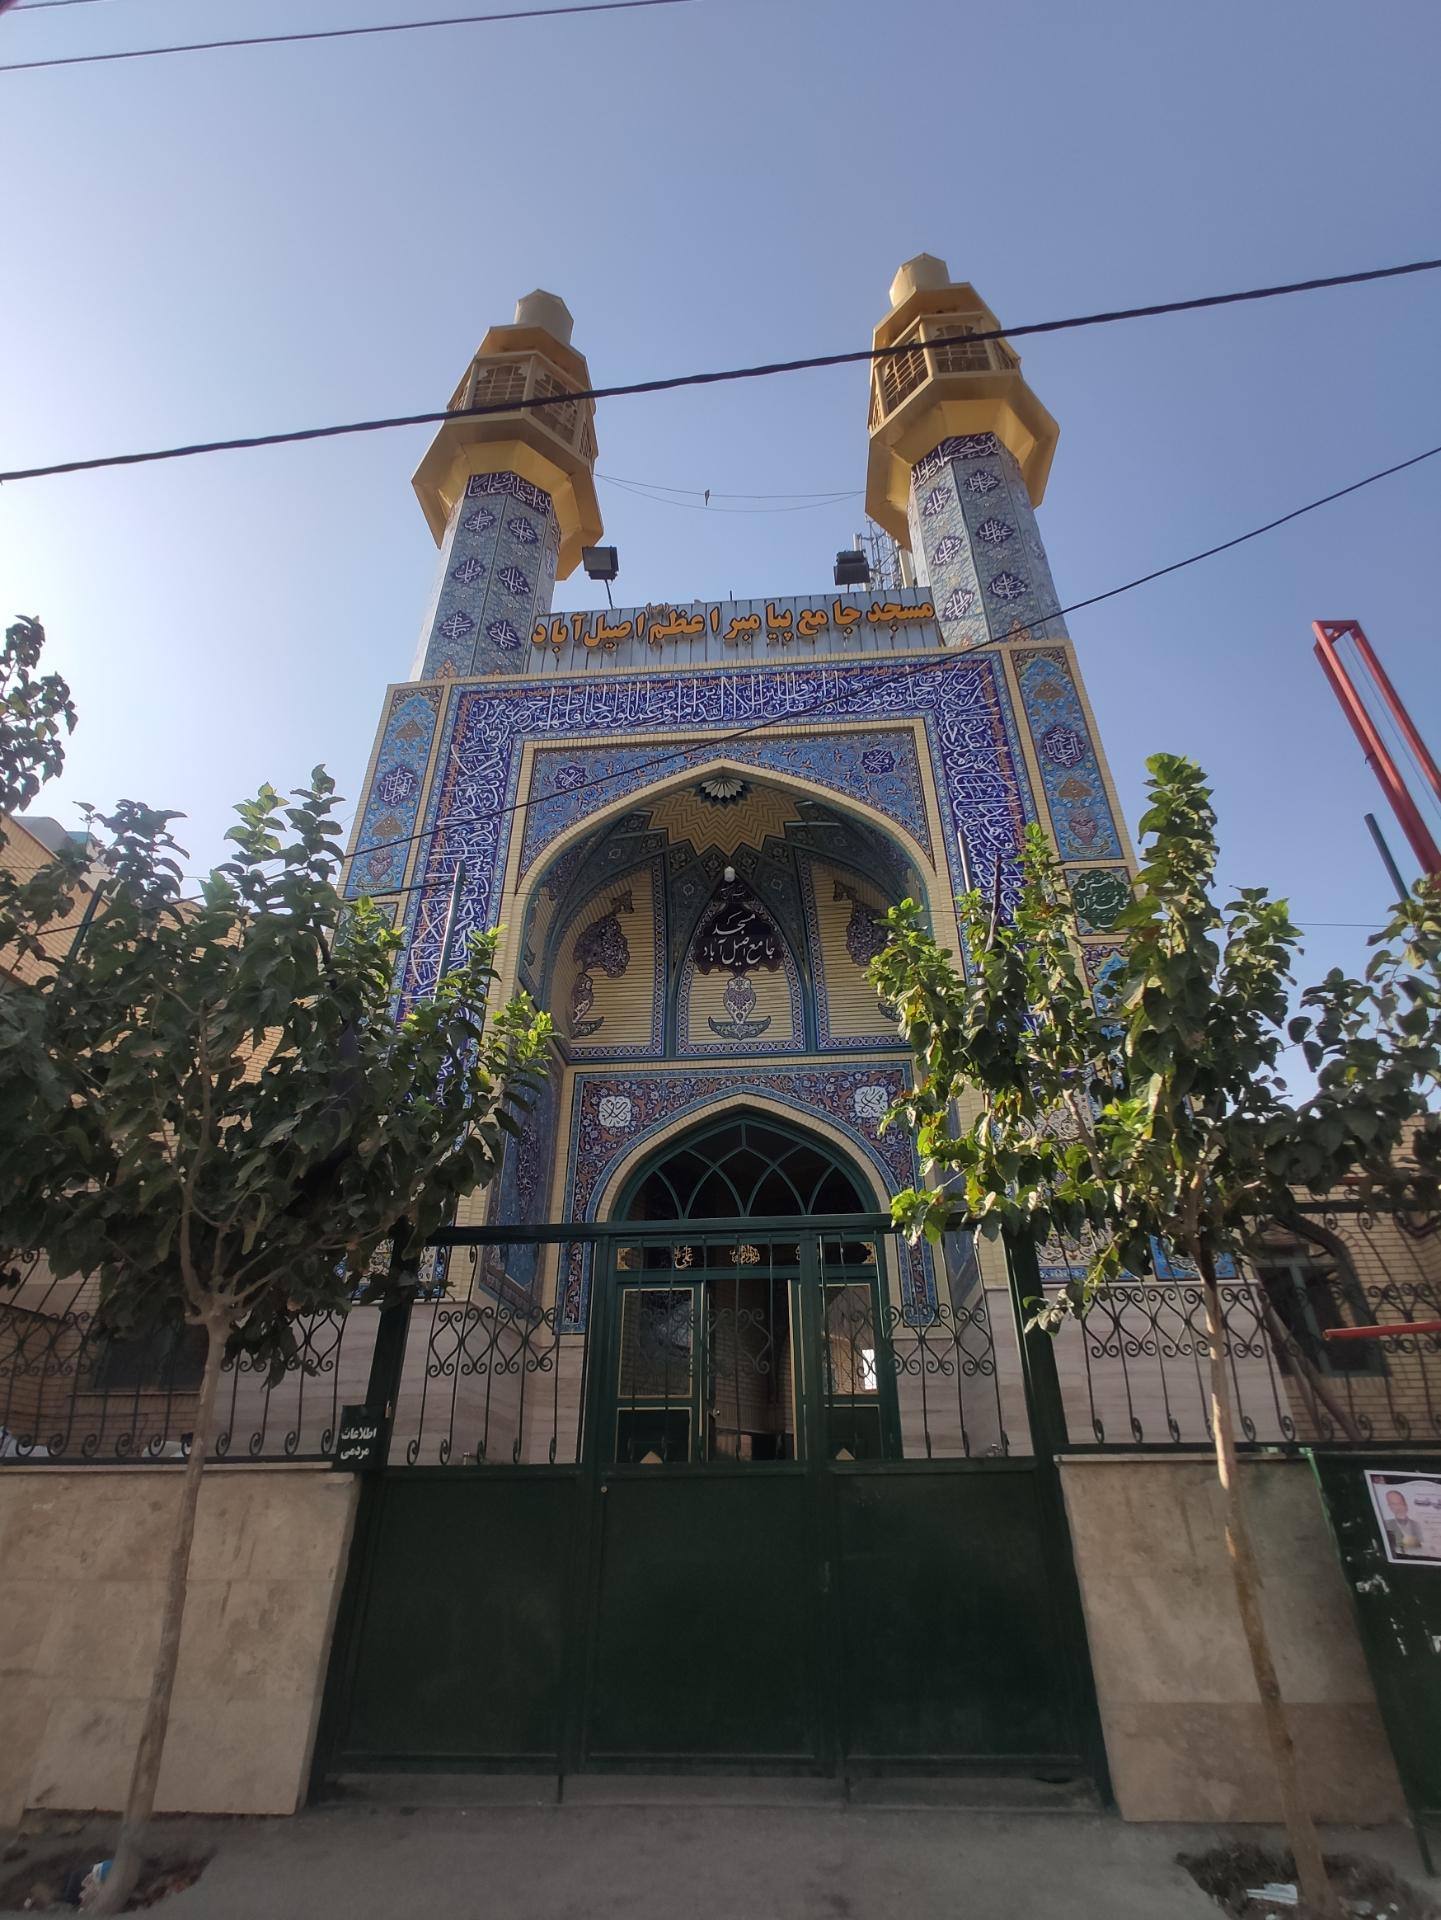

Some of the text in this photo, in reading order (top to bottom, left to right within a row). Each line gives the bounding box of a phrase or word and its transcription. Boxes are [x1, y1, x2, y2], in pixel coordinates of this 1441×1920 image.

[582, 610, 647, 651] اصیل
[647, 606, 720, 645] اعظم
[797, 599, 862, 637] جامع
[866, 601, 936, 632] مسجد
[530, 613, 587, 654] آباد
[712, 912, 756, 935] مسجد
[703, 936, 775, 966] جامع اصیل آباد
[341, 1426, 377, 1440] اطلاعات
[340, 1445, 370, 1460] مردمی
